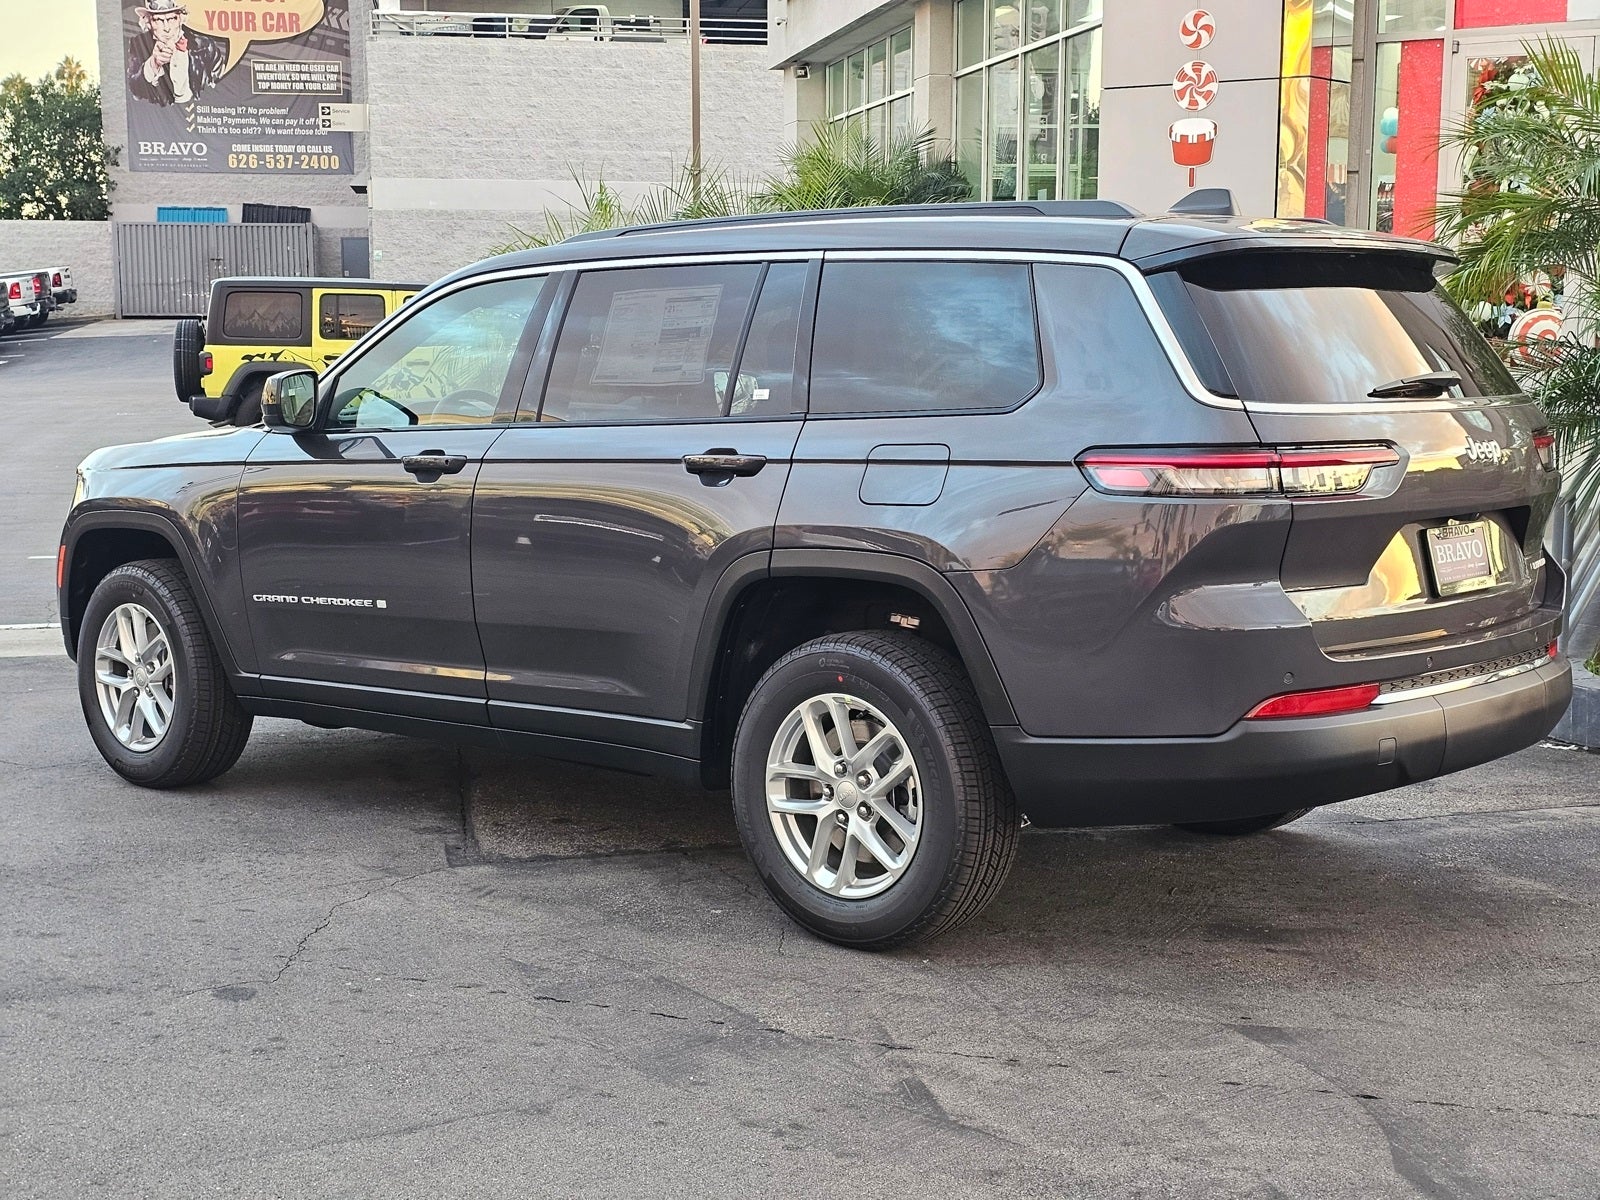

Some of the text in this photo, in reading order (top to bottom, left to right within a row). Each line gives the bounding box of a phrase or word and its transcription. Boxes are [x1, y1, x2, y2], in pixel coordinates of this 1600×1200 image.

[204, 10, 301, 33] YOUR CAR
[254, 63, 264, 71] WE
[265, 63, 277, 71] ARE
[285, 64, 300, 72] NEED
[301, 64, 309, 72] OF
[310, 64, 325, 72] USED
[256, 72, 291, 81] INVENTORY,
[291, 73, 300, 81] SO
[326, 74, 337, 82] PAY
[258, 82, 270, 90] TOP
[271, 82, 292, 90] MONEY
[292, 82, 304, 90] FOR
[196, 106, 210, 114] Still
[211, 106, 236, 115] leasing
[258, 107, 288, 115] problem!
[197, 116, 221, 125] Making
[223, 116, 258, 125] Payments,
[285, 118, 297, 126] pay
[197, 126, 216, 134] Think
[218, 126, 228, 134] it's
[242, 126, 262, 134] old??
[265, 127, 276, 135] We
[138, 141, 208, 156] BRAVO
[232, 144, 333, 153] COME INSIDE TODAY OR CALL US
[228, 154, 340, 170] 626-537-2400
[1465, 435, 1501, 465] Jeep
[1442, 525, 1470, 538] BRAVO
[1435, 539, 1483, 564] BRAVO
[252, 594, 299, 603] GRAND
[301, 596, 374, 607] CHEROKEE
